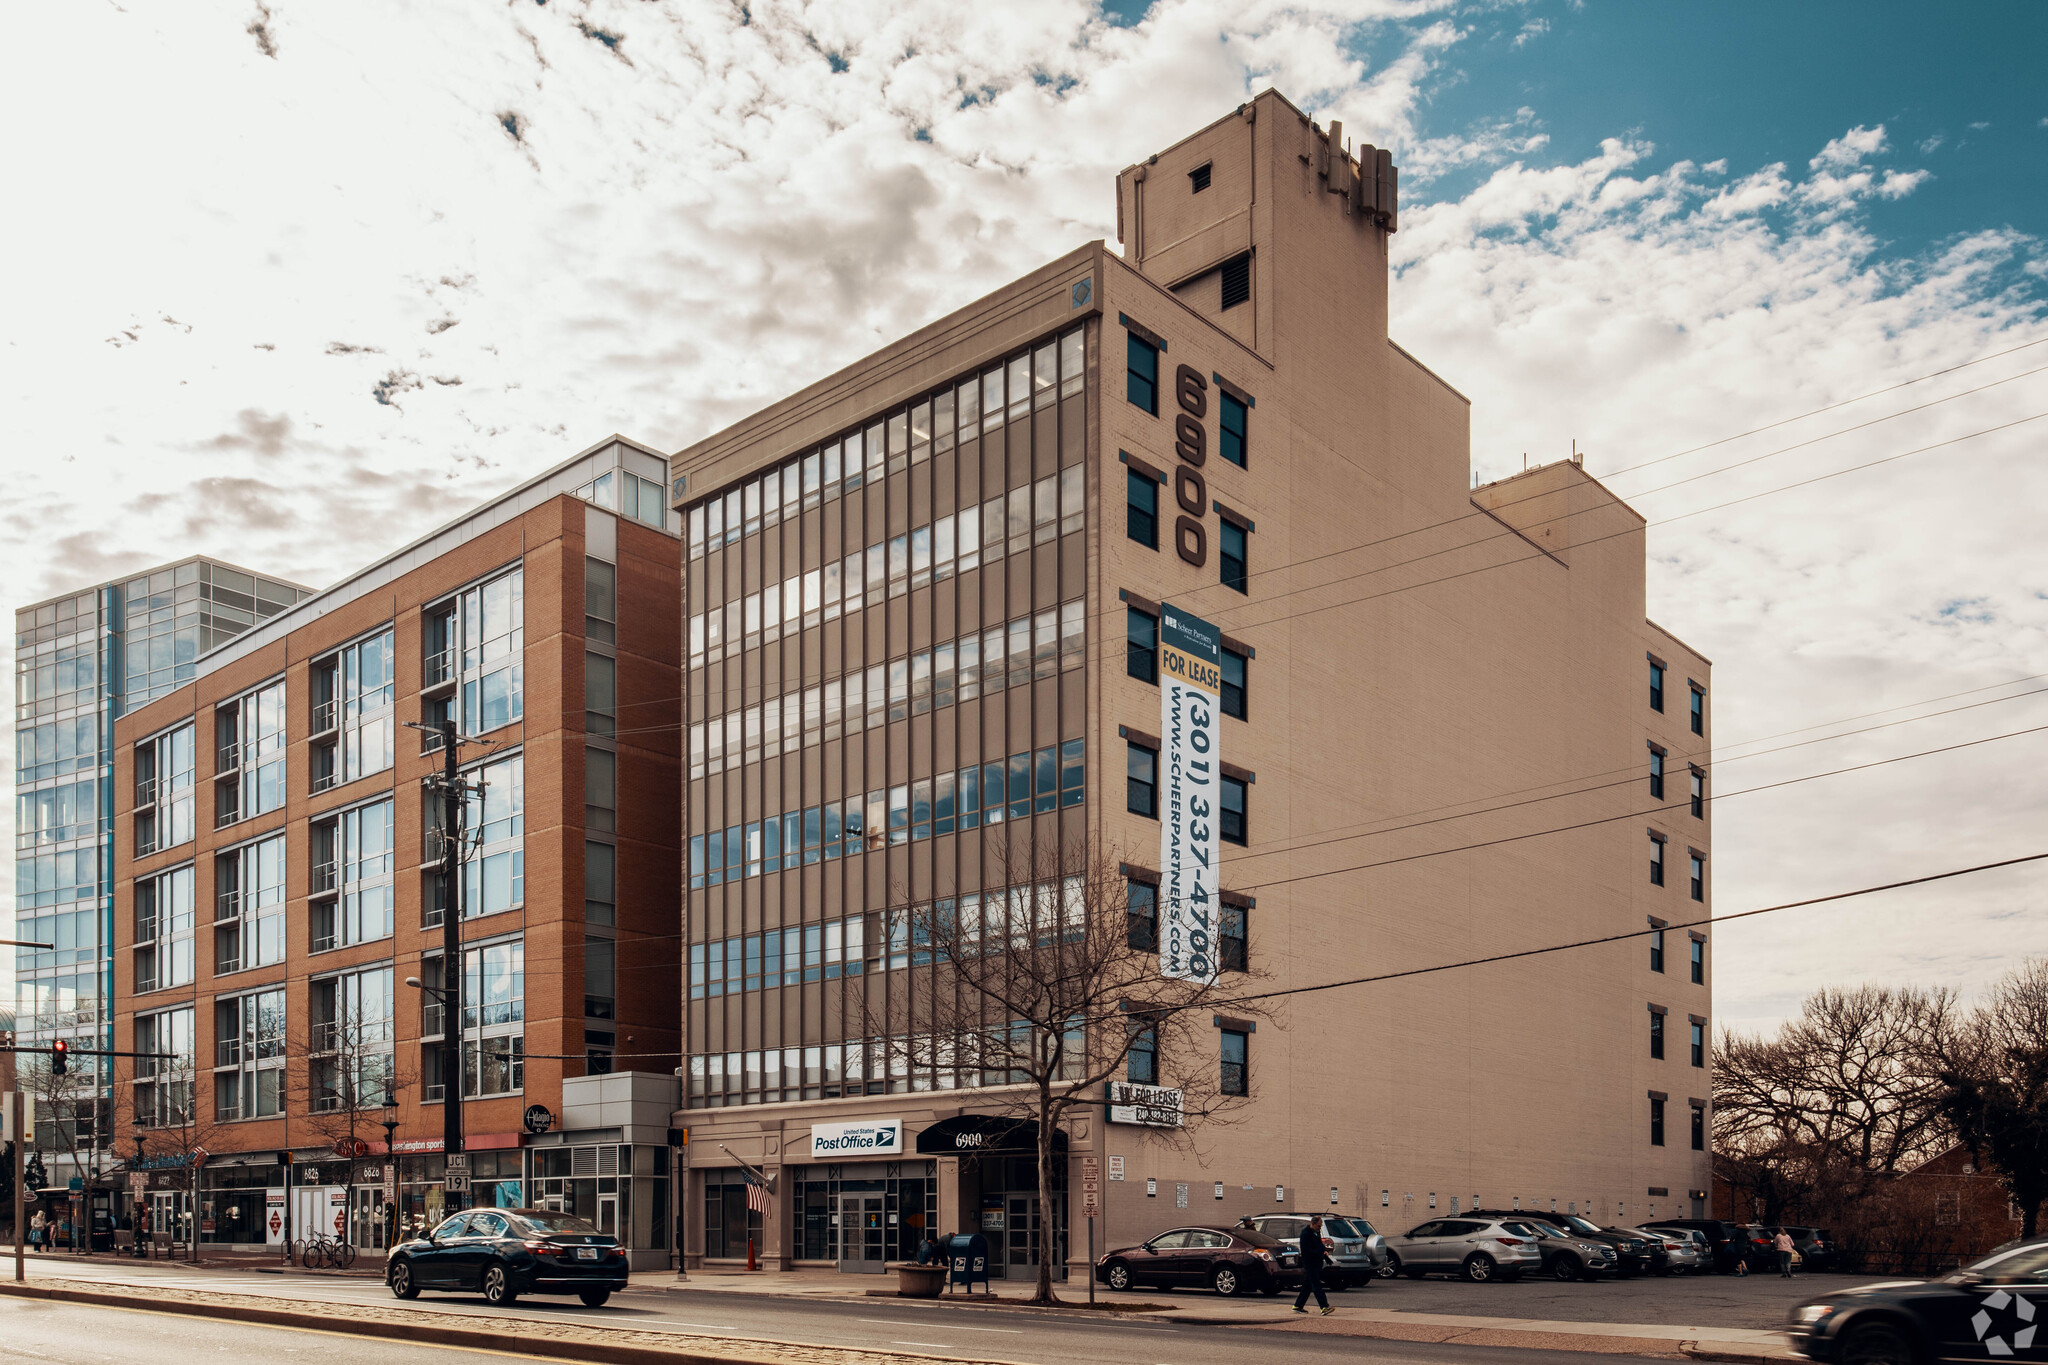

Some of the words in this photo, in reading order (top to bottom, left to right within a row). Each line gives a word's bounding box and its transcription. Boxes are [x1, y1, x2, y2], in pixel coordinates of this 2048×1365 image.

[1176, 363, 1208, 568] 6900
[1193, 629, 1212, 645] Partners
[1163, 649, 1186, 676] FOR
[1188, 660, 1219, 689] LEASE
[1186, 691, 1211, 786] (301)
[1170, 686, 1182, 973] WWW.SCHEERPARTNERS.COM
[1189, 794, 1210, 978] 337-4700
[1136, 1088, 1151, 1104] FOR
[1152, 1090, 1178, 1107] LEASE
[815, 1137, 840, 1150] Post
[840, 1135, 873, 1149] Office
[956, 1132, 982, 1149] 6900
[449, 1156, 465, 1167] JCT
[304, 1167, 319, 1180] 6826
[448, 1177, 469, 1190] 191
